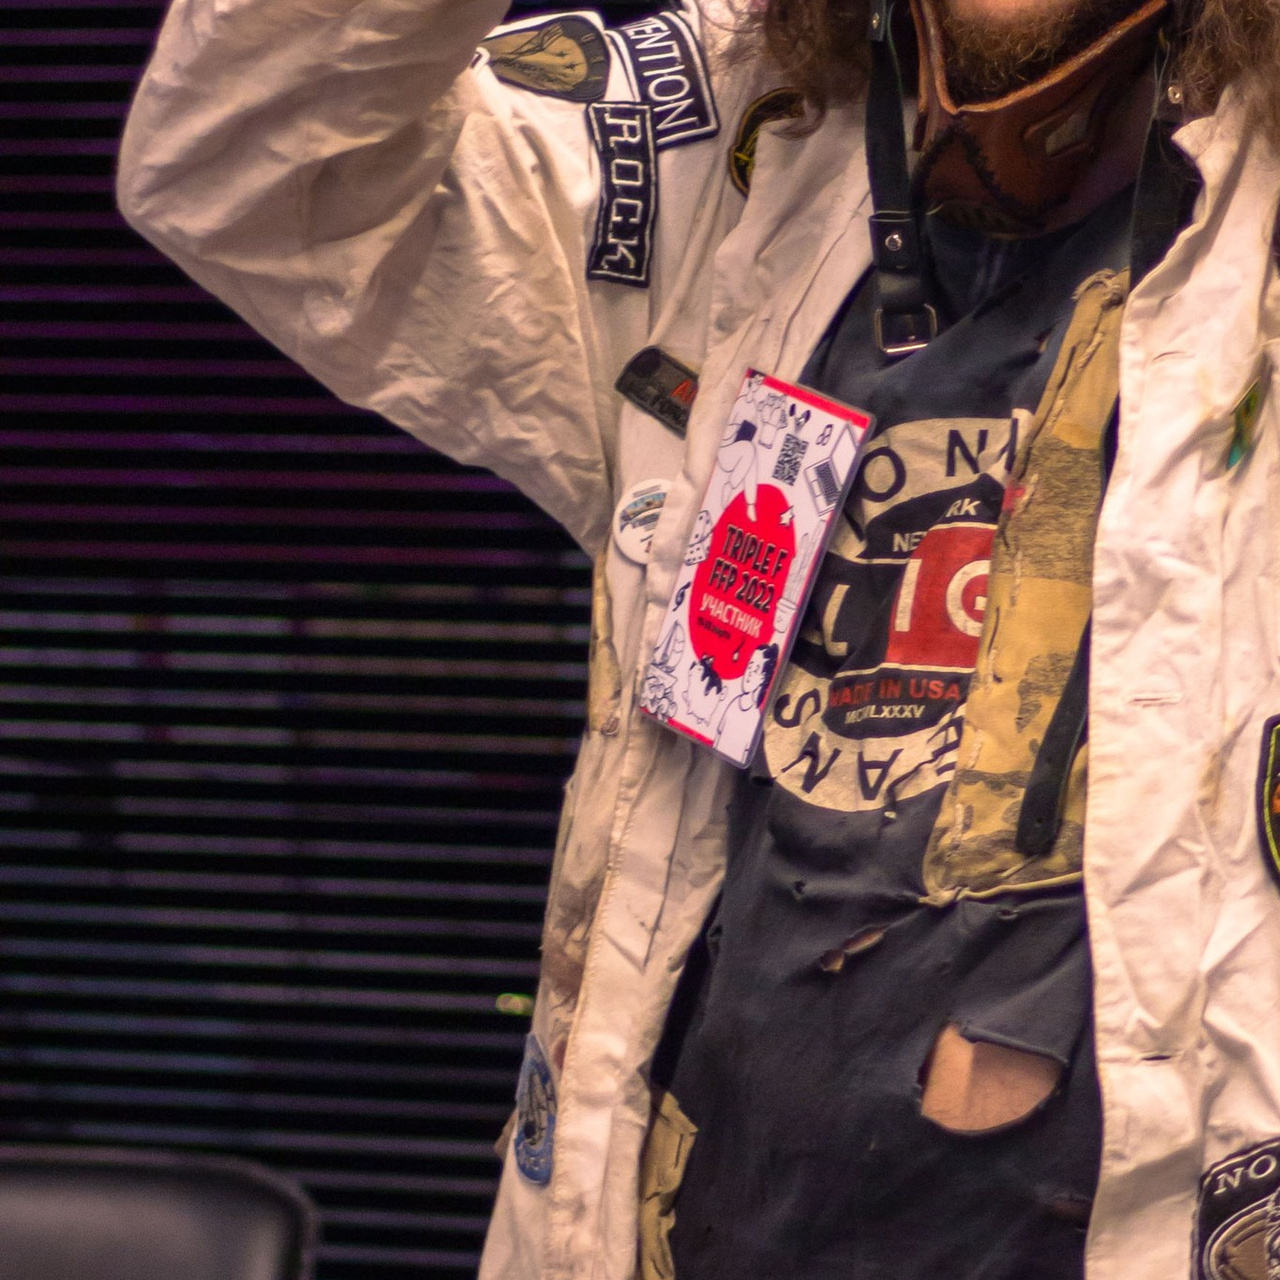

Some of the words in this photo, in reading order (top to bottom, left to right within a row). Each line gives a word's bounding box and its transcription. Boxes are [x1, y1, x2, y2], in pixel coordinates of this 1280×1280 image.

[622, 17, 699, 132] ENTION
[603, 109, 645, 271] ROCK
[722, 523, 776, 575] TRIPLE
[771, 548, 788, 579] F
[708, 556, 738, 593] FFP
[734, 570, 775, 614] 2022
[699, 592, 763, 639] УЧАСТНИК
[909, 677, 960, 701] USA
[1213, 1154, 1278, 1196] NO
